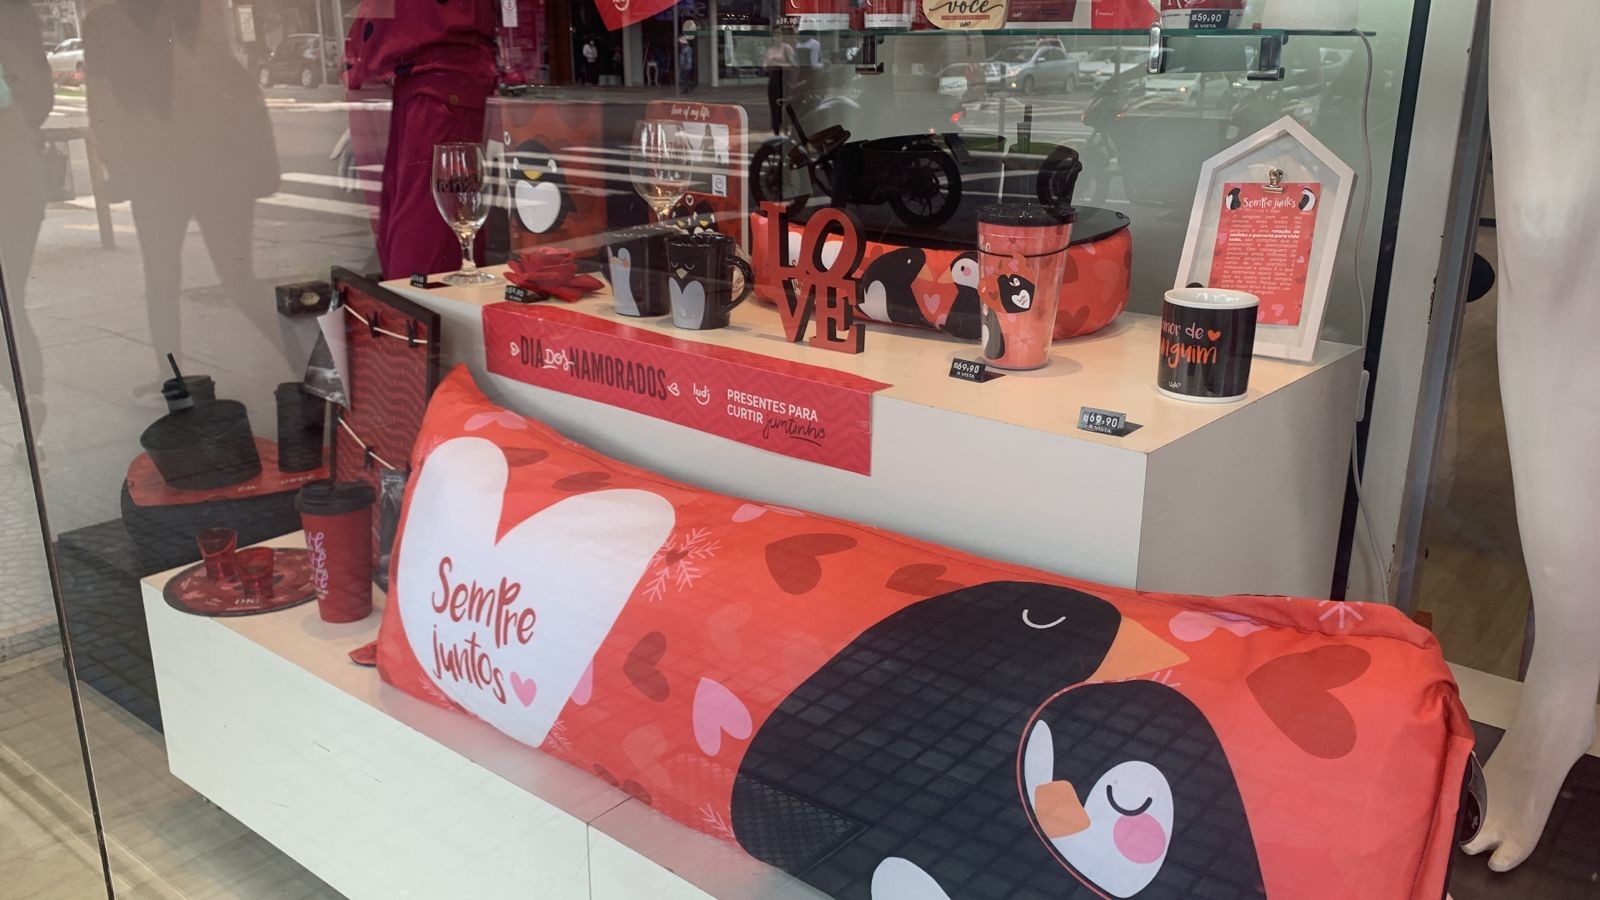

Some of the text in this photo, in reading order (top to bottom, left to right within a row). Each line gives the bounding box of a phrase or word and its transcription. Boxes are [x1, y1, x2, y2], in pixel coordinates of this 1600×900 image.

[1162, 320, 1204, 340] mor de
[520, 335, 544, 368] DIA
[569, 347, 668, 401] NAMORADOS
[727, 389, 818, 422] PRESENTES PARA
[727, 404, 826, 440] CURTIR juntinho
[1094, 425, 1112, 434] VISTA
[432, 556, 536, 649] Sempre
[433, 623, 507, 704] juntos
